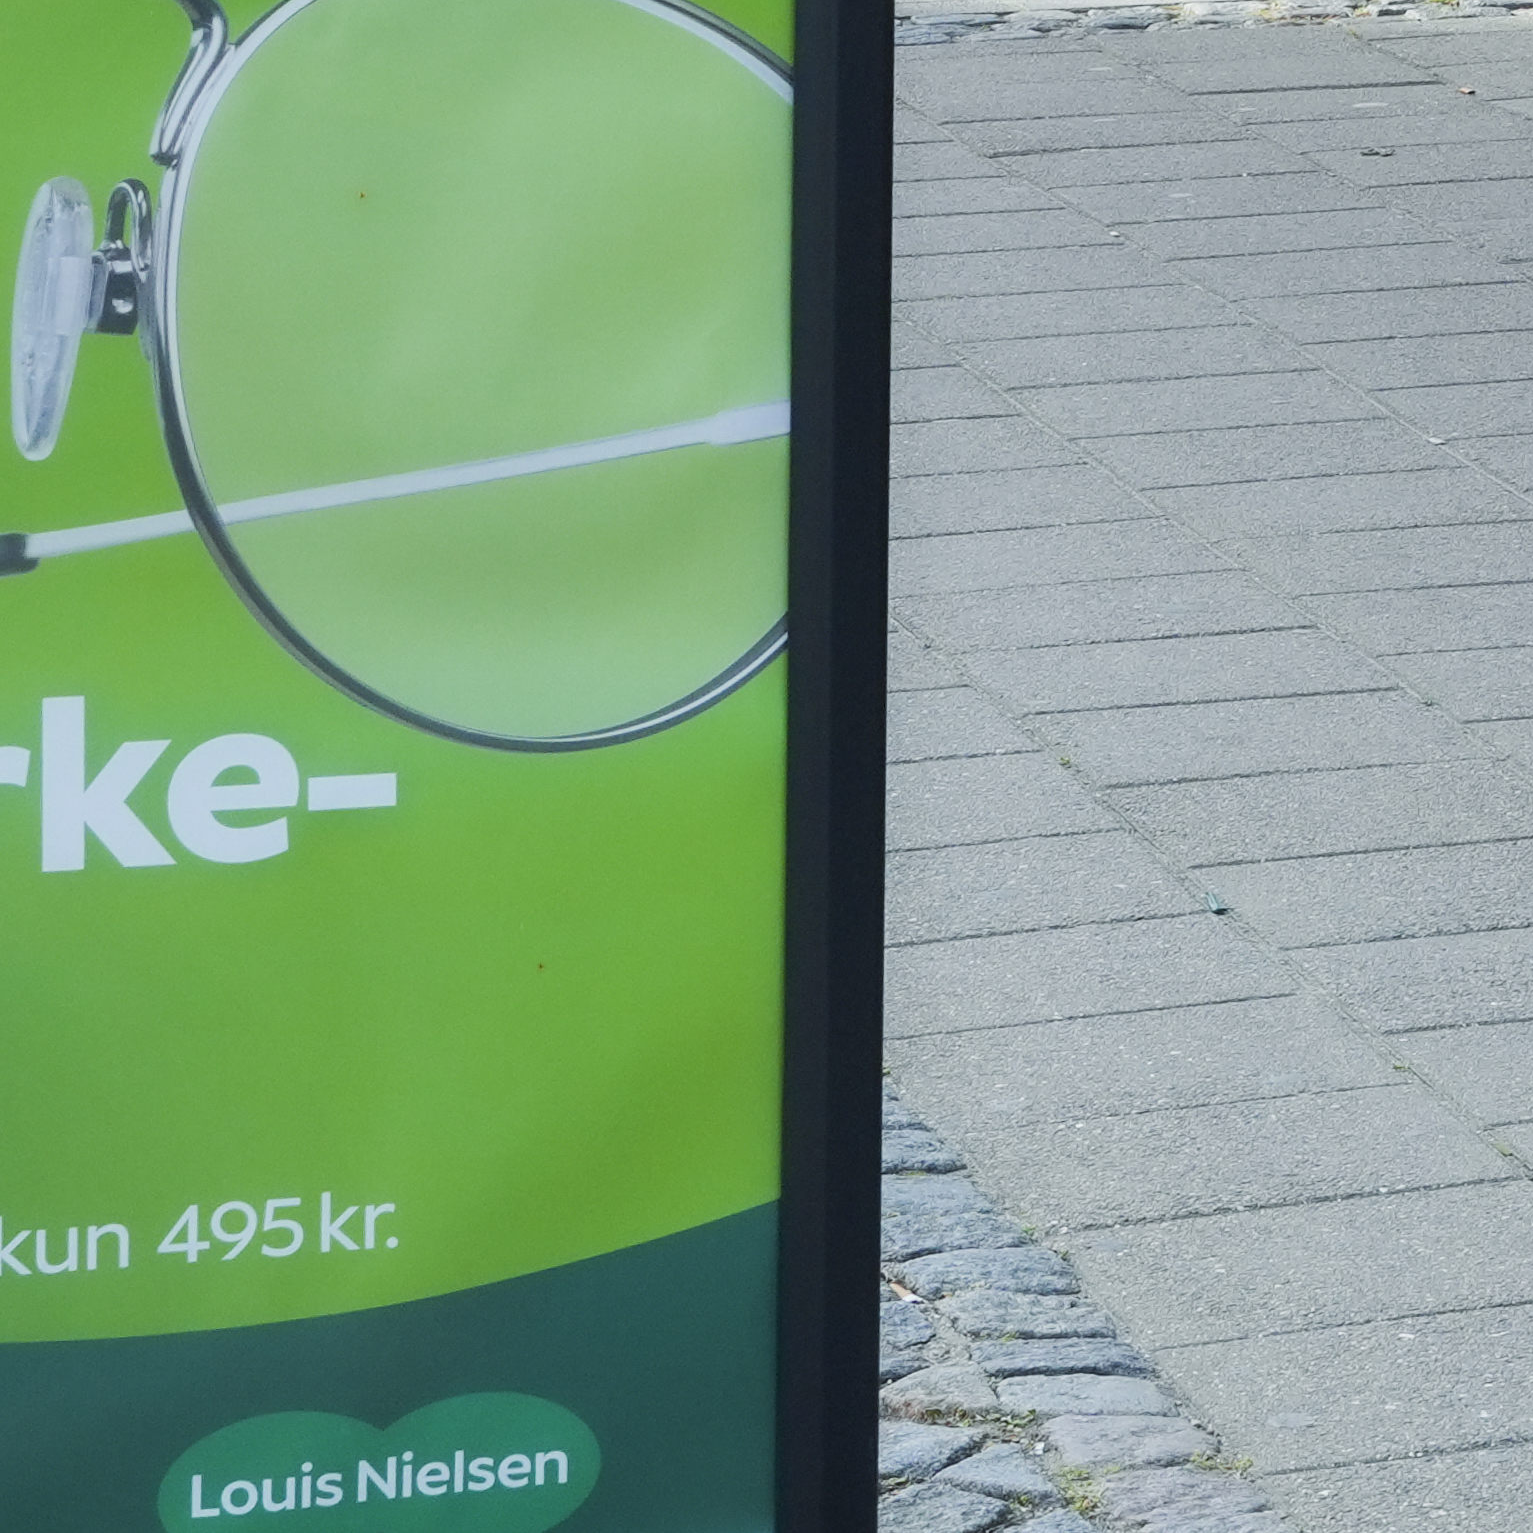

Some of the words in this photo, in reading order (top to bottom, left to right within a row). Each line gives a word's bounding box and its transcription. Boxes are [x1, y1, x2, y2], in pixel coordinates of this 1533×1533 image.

[0, 1215, 131, 1277] kun
[155, 1197, 305, 1265] 495
[320, 1191, 401, 1254] kr.
[189, 1460, 344, 1520] Louis
[355, 1445, 569, 1506] Nielsen
